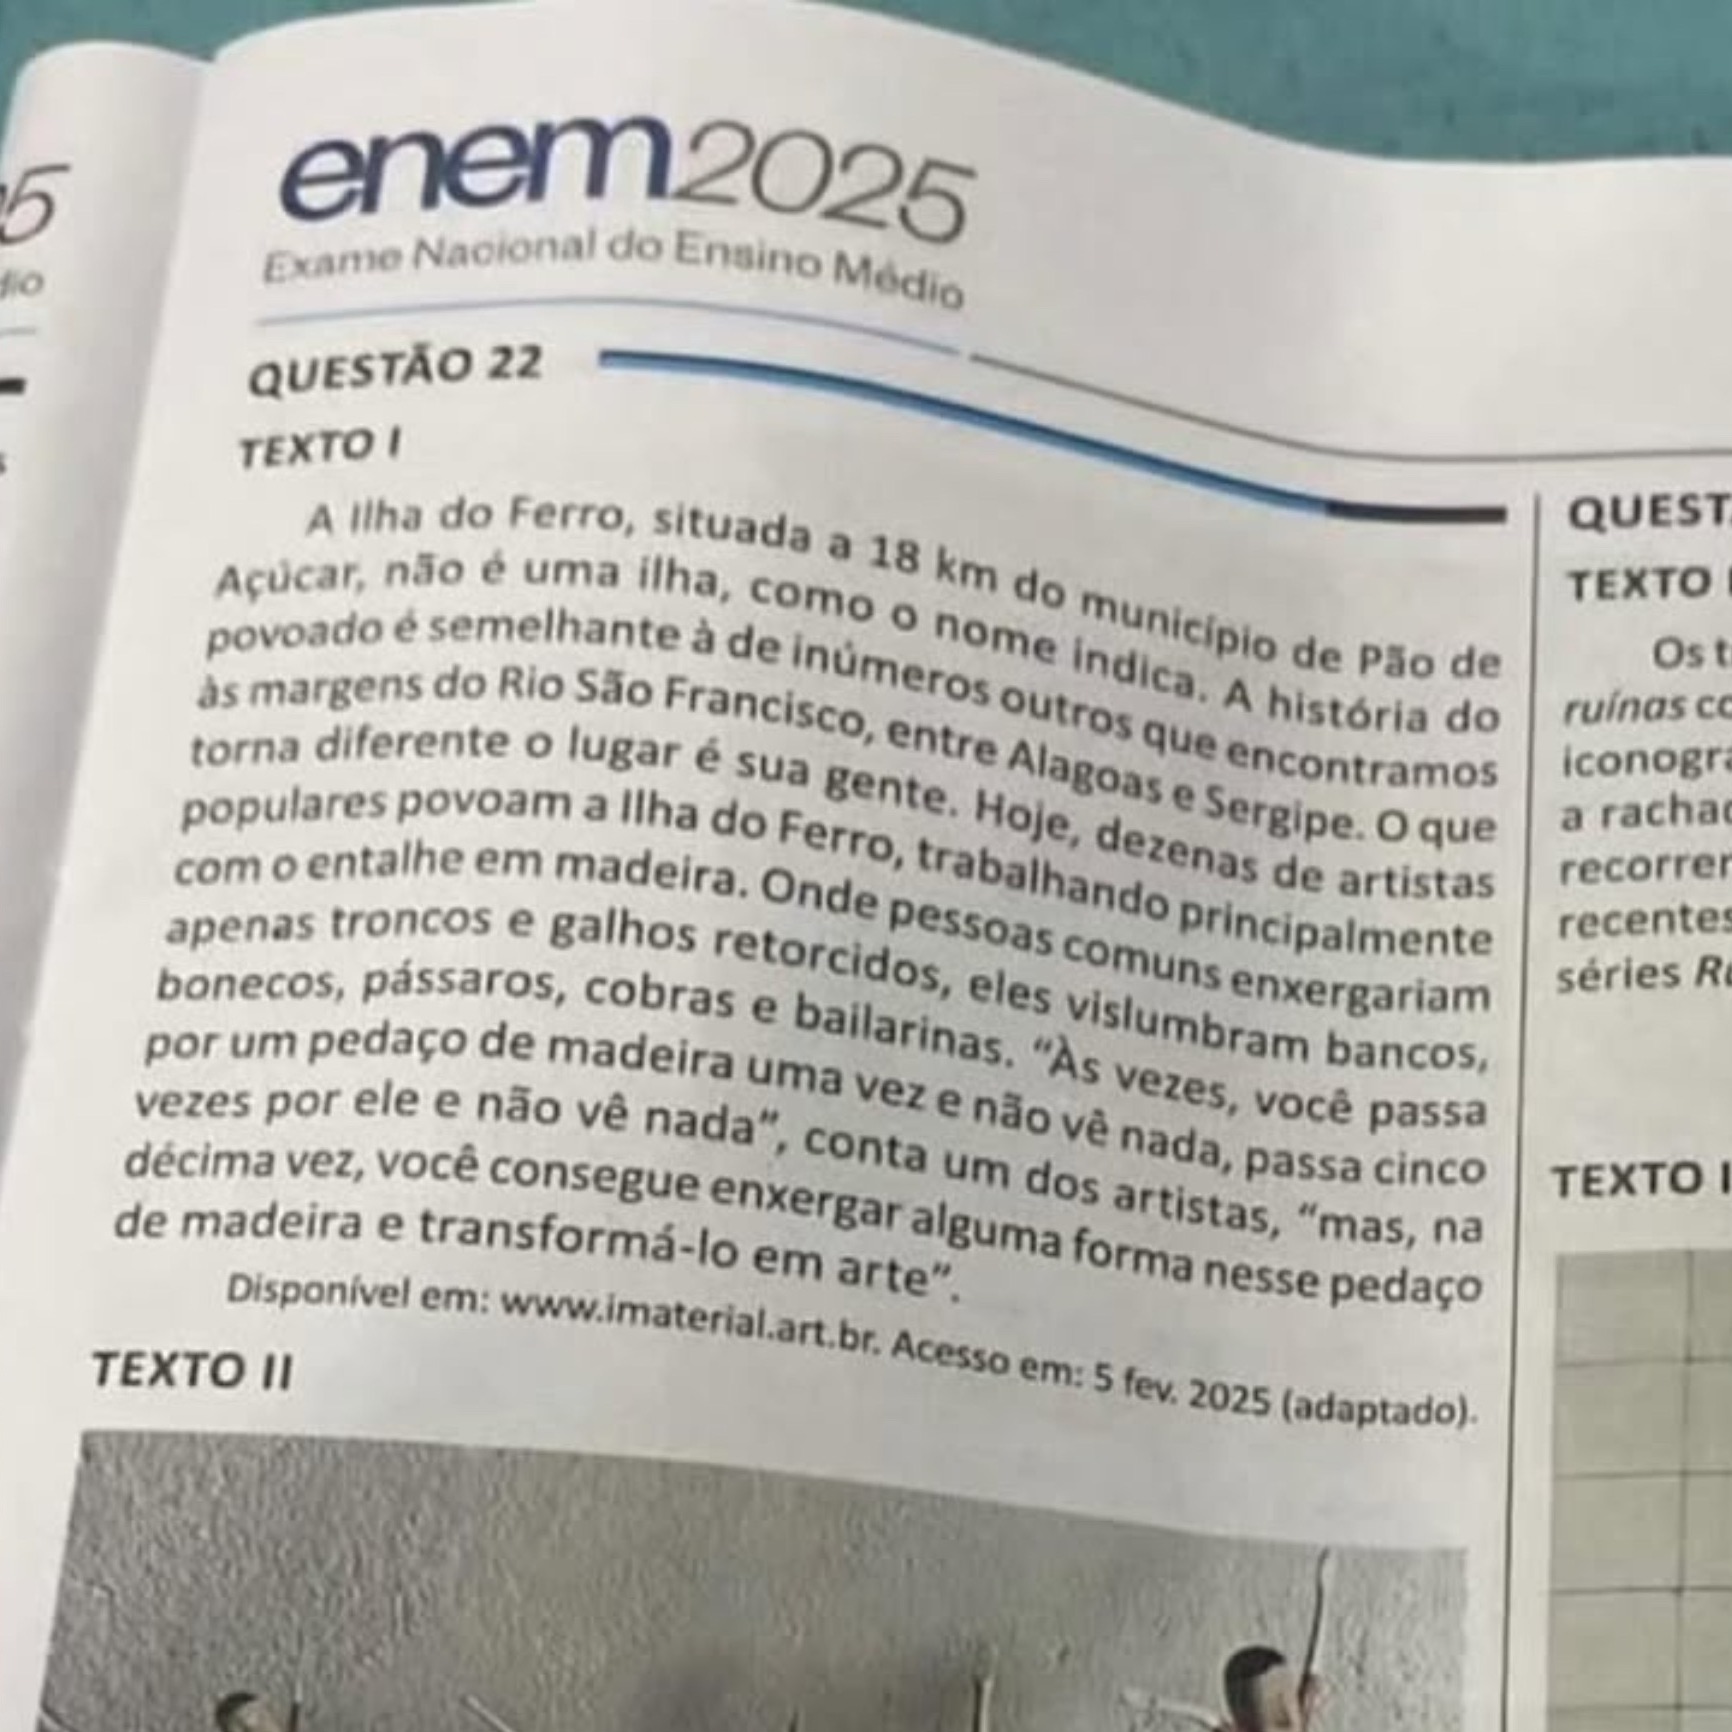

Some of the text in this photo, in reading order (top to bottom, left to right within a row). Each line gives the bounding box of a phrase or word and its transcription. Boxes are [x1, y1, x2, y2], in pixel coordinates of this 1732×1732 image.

[262, 227, 965, 312] Exame Nacional do Ensino Médio
[248, 341, 543, 400] QUESTÃO 22
[238, 424, 402, 470] TEXTO I
[1568, 492, 1732, 534] QUEST
[1565, 565, 1712, 603] TEXTO
[1653, 635, 1704, 670] Os
[1563, 689, 1686, 726] ruínas
[180, 785, 1493, 956] populares povoam a Ilha do Ferro, trabalhando principalmente
[174, 838, 1491, 1018] com o entalhe em madeira. Onde pessoas comuns enxergariam
[165, 907, 1488, 1075] apenas troncos e galhos retorcidos, eles vislumbram bancos,
[1557, 957, 1681, 994] séries
[156, 959, 1487, 1135] bonecos, pássaros, cobras e bailarinas. “Às vezes, você passa
[1549, 1160, 1704, 1199] TEXTO
[124, 1141, 1483, 1313] décima vez, você consegue enxergar alguma forma nesse pedaço
[91, 1350, 293, 1391] TEXTO II
[227, 1272, 1478, 1431] Disponível em: www.imaterial.art.br. Acesso em: 5 fev. 2025 (adaptado).
